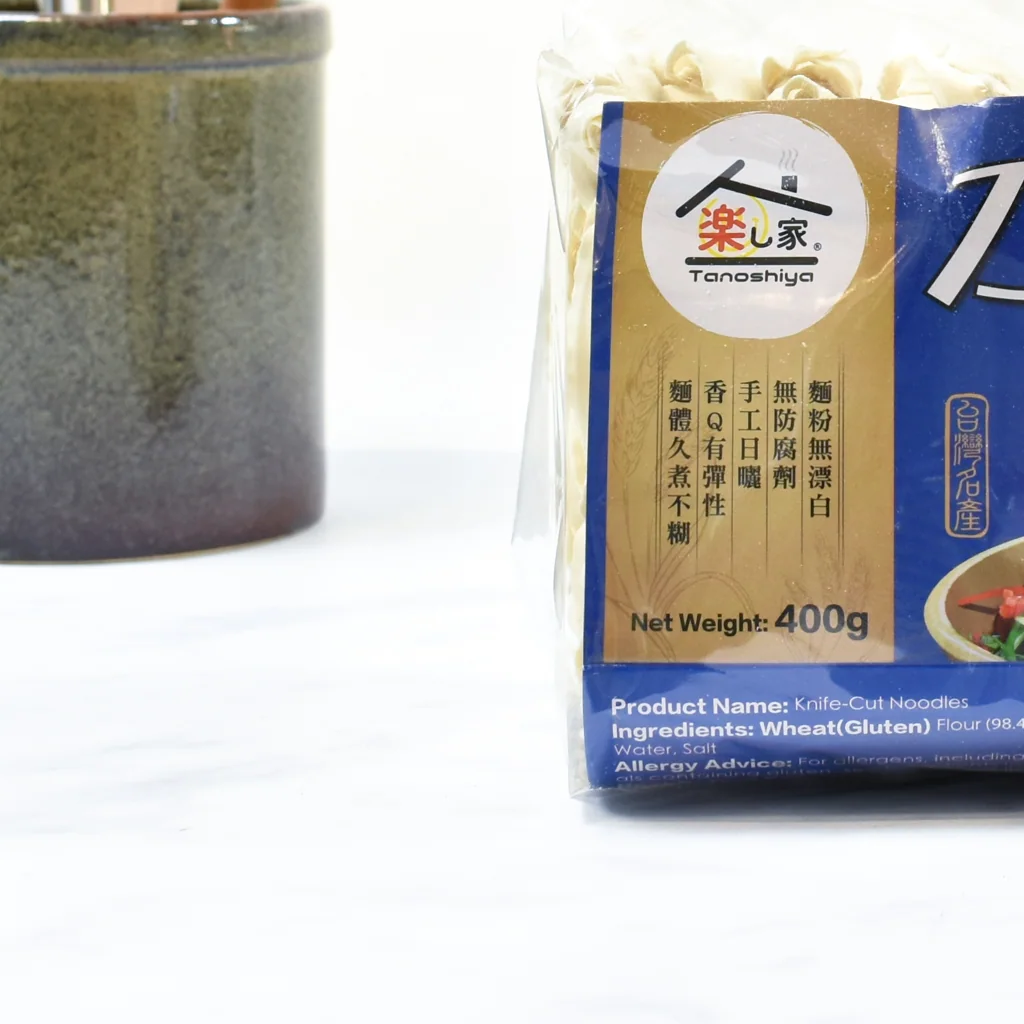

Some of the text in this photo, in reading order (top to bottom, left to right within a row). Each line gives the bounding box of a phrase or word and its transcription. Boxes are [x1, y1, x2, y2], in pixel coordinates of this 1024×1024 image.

[698, 204, 808, 253] 楽し家
[689, 268, 814, 287] Tanoshiya
[702, 380, 727, 518] 香Q有彈性
[737, 381, 762, 489] 手工日曬
[773, 380, 797, 490] 無防腐劑
[808, 380, 832, 518] 麵粉無漂白
[667, 379, 692, 546] 麵體久煮不糊
[631, 604, 869, 641] Net Weight: 400g
[611, 695, 969, 716] Product Name: Knife-Cut Noodles
[611, 723, 754, 741] Ingredients:
[759, 719, 931, 738] Wheat(Gluten)
[937, 718, 981, 732] Flour
[614, 742, 717, 756] Water, Salt
[614, 760, 698, 773] Allergy
[704, 758, 792, 771] Advice:
[799, 756, 827, 766] For
